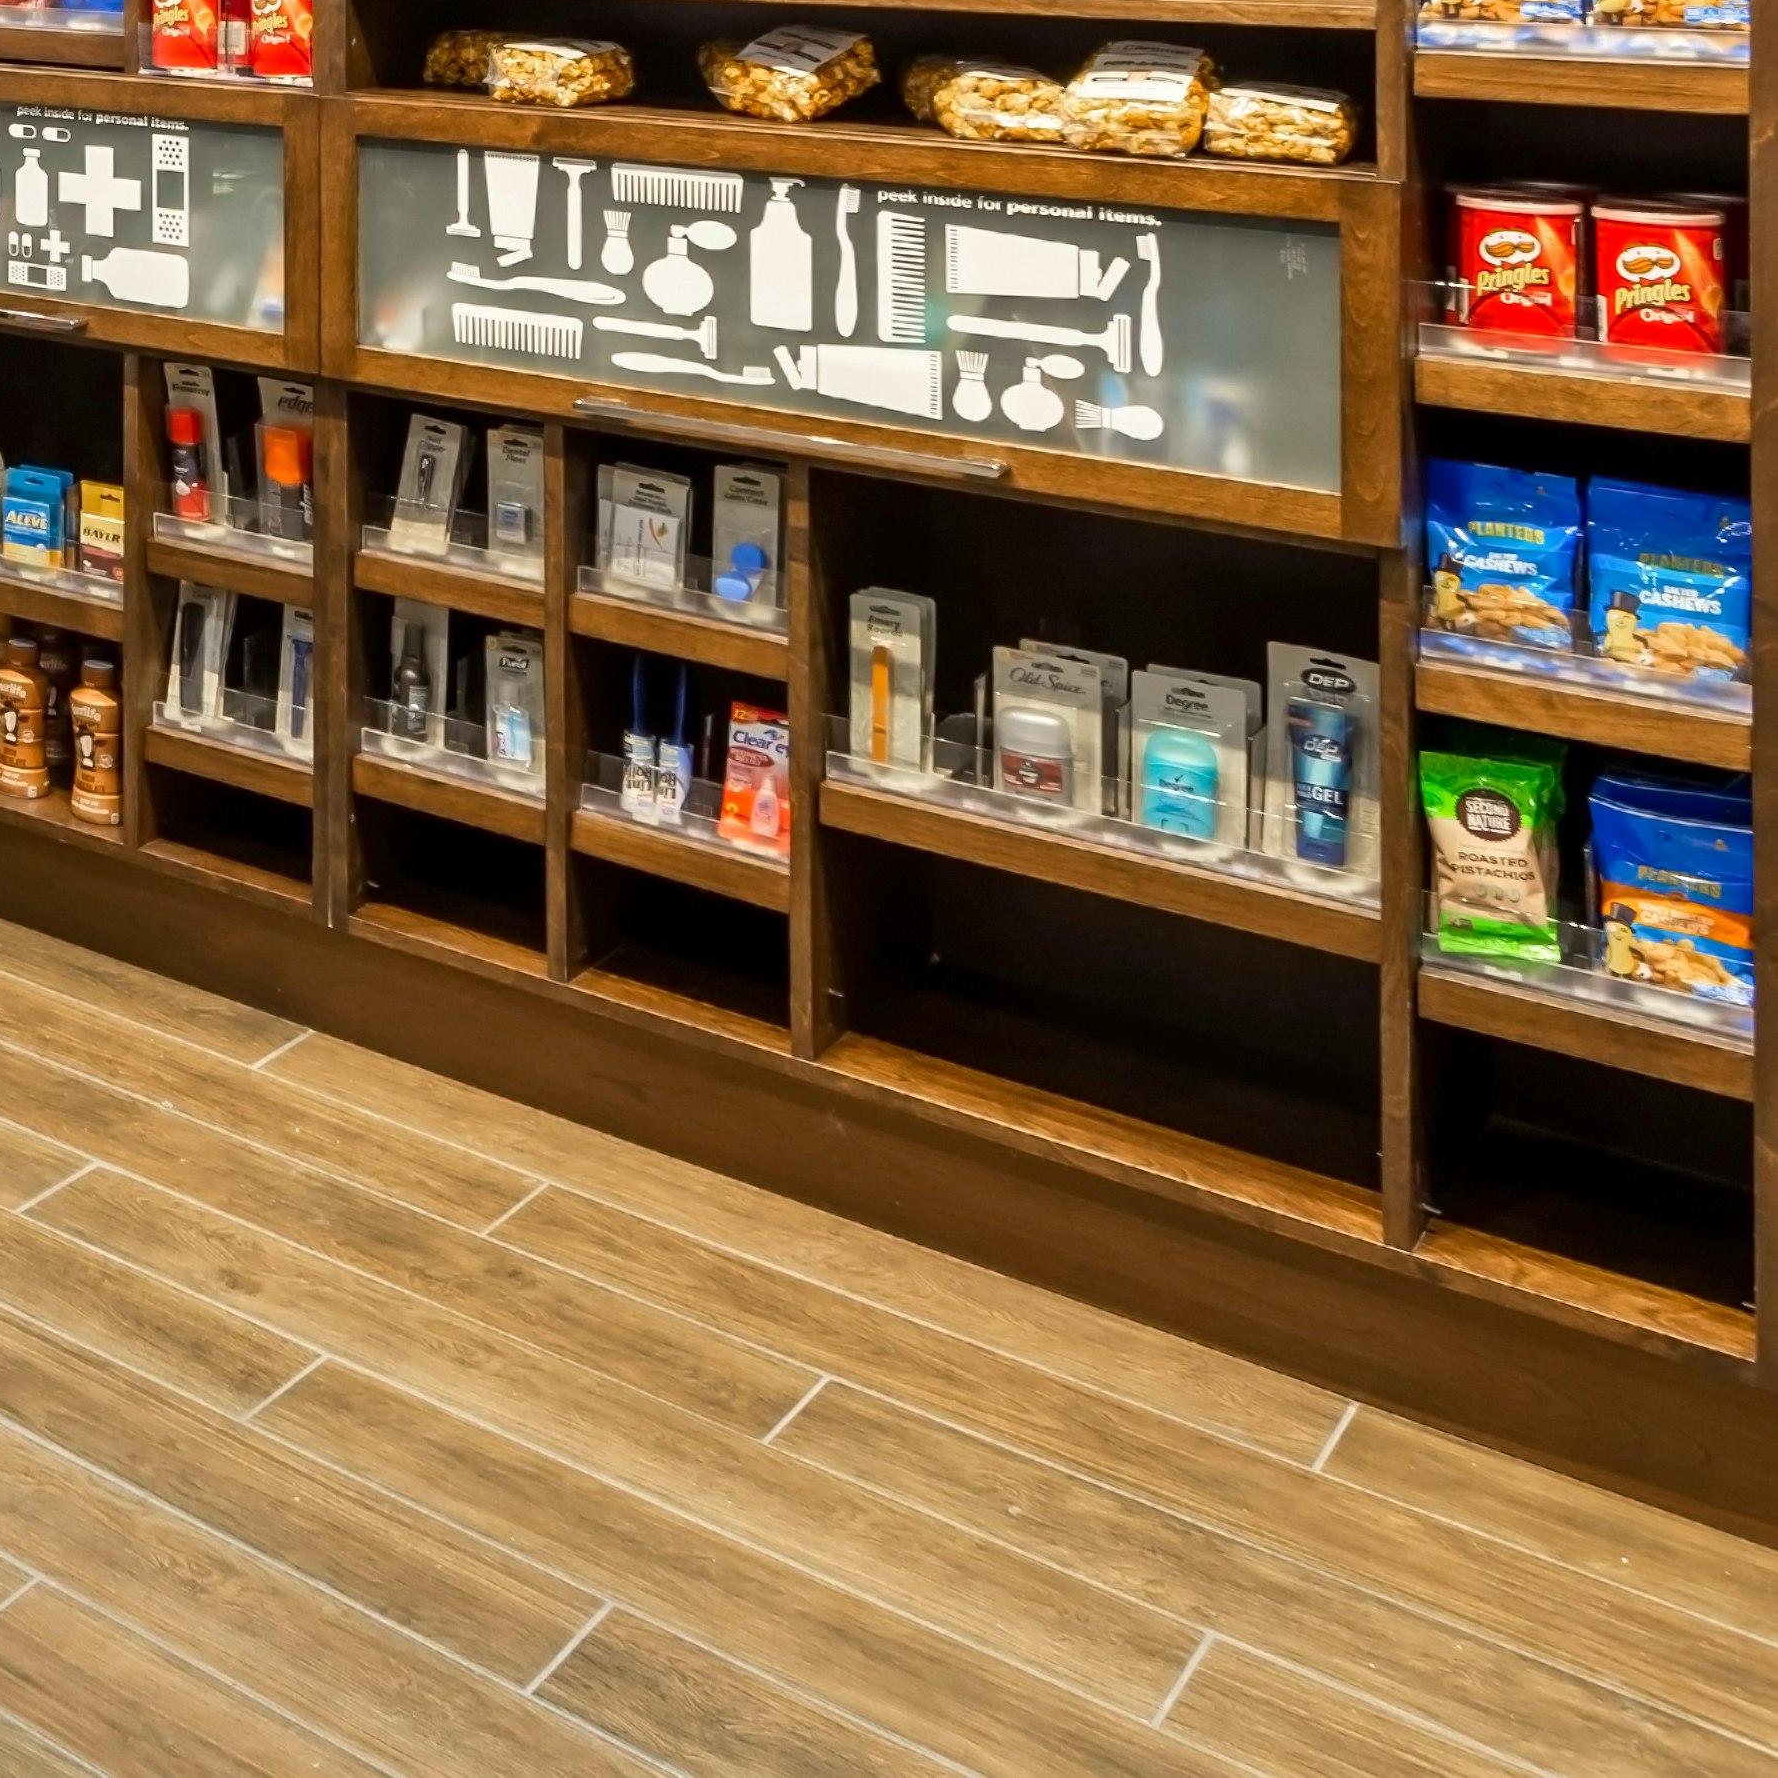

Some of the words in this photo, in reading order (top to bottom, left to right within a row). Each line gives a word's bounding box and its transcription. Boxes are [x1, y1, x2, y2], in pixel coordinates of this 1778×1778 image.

[153, 6, 189, 31] Pringles
[252, 12, 288, 35] Pringles
[17, 106, 42, 117] peek
[44, 107, 74, 119] inside
[78, 110, 94, 121] for
[96, 113, 147, 127] personal
[151, 117, 189, 131] items.
[877, 190, 918, 204] peek
[922, 191, 973, 209] inside
[977, 196, 1003, 211] for
[1006, 201, 1093, 220] personal
[1098, 207, 1162, 226] items.
[1477, 263, 1549, 297] Pringles
[1615, 279, 1692, 315] Pringles
[277, 395, 314, 414] edge
[5, 510, 48, 531] ALEVE
[83, 526, 122, 543] BAYER
[1467, 520, 1545, 545] PLANTERS
[1462, 555, 1538, 576] CASHEWS
[1638, 553, 1725, 577] PLANTERS
[1638, 589, 1722, 615] CASHEWS
[1663, 585, 1699, 598] SALTED
[1009, 667, 1042, 685] Old
[1042, 674, 1087, 695] Spice
[1308, 673, 1351, 689] DEP
[1165, 694, 1209, 712] Degree
[733, 730, 771, 750] Clear
[1312, 787, 1344, 805] GEL
[1465, 798, 1511, 818] SECOND
[1466, 814, 1512, 833] NATURE
[1458, 851, 1528, 869] ROASTED
[1450, 863, 1536, 882] PISTACHIOS
[1641, 910, 1710, 936] CASHEWS
